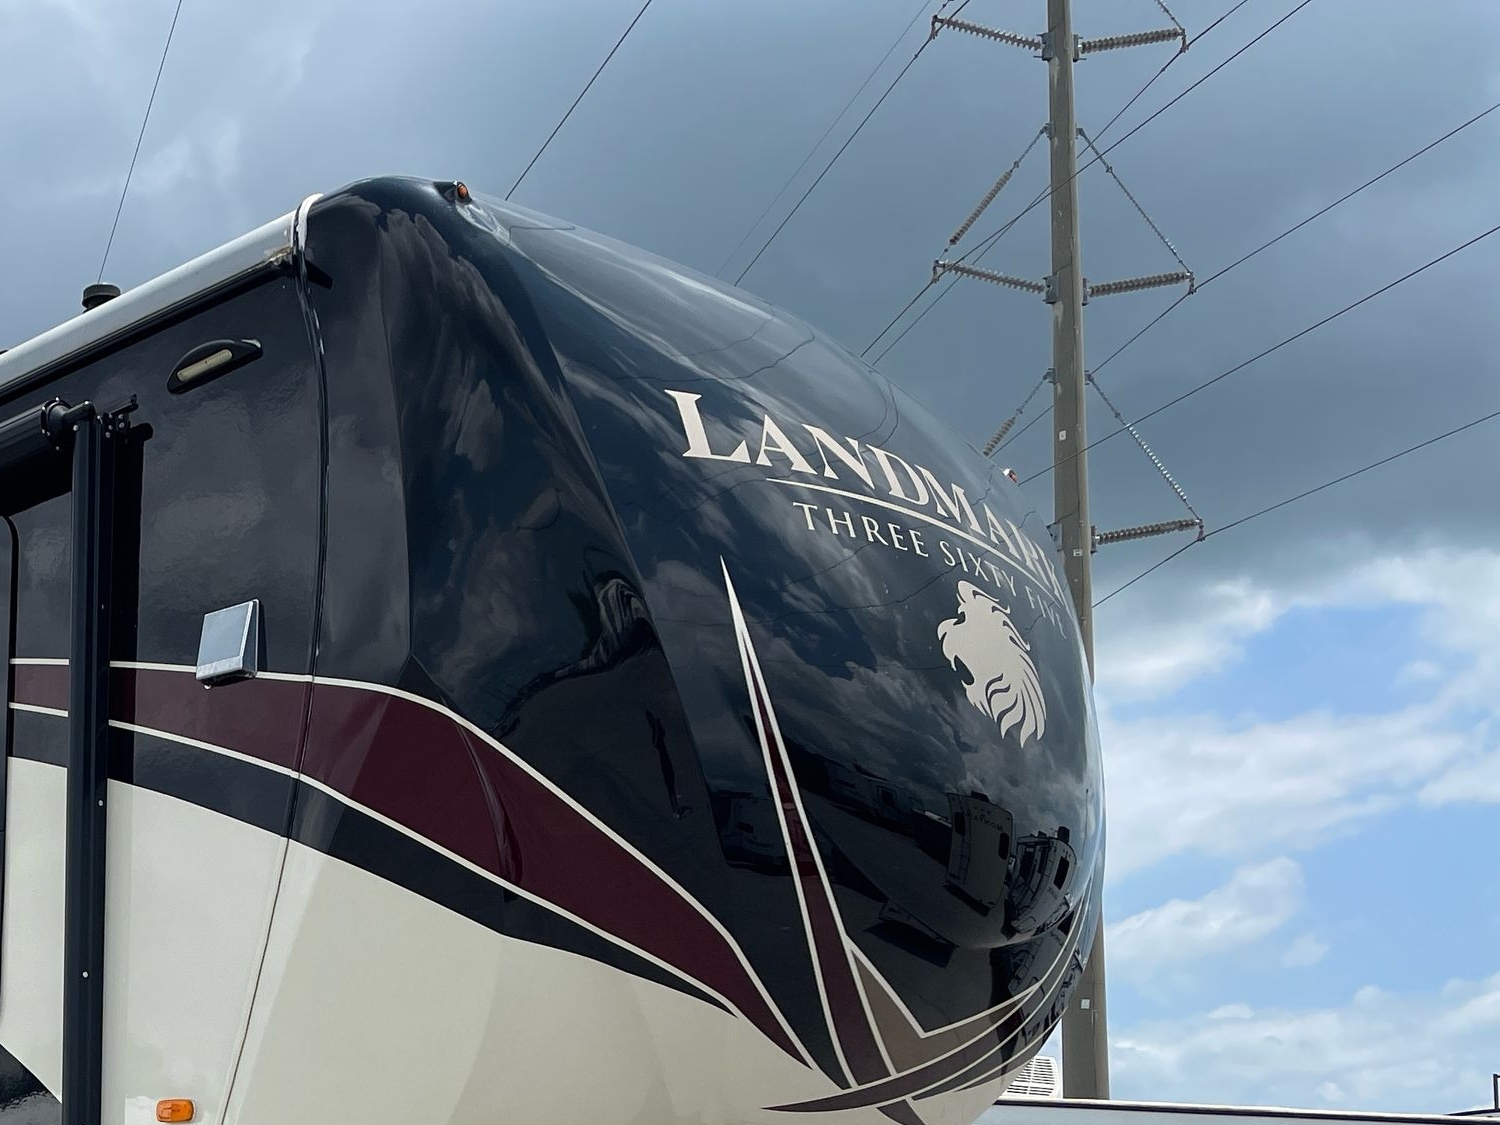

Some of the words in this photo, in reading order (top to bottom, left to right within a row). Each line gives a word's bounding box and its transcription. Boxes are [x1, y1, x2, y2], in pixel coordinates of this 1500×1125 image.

[664, 389, 1069, 613] LANDMARK
[793, 502, 929, 557] THREE
[940, 540, 1017, 596] SIXTY
